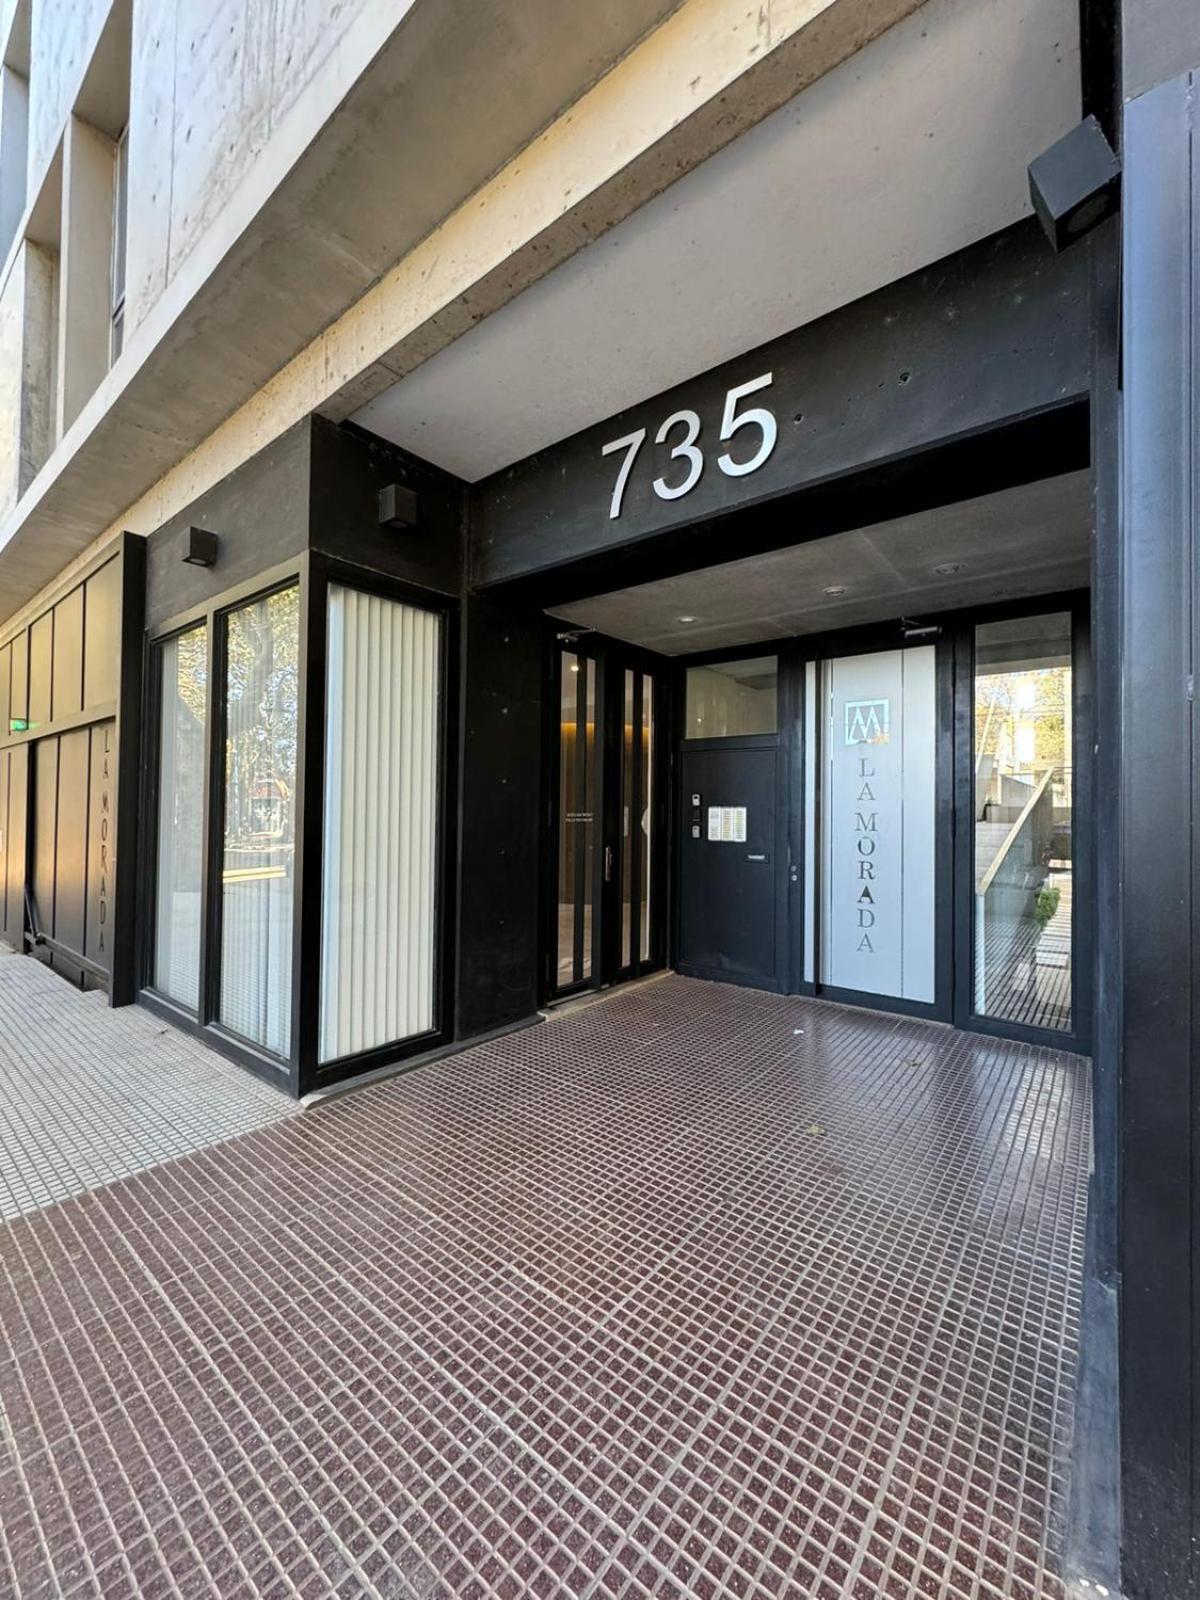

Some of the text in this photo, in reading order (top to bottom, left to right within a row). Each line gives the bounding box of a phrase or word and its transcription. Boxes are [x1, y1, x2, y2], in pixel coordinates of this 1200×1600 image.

[601, 372, 777, 519] 735
[98, 729, 110, 953] LA MORADA
[854, 758, 878, 953] LA MORADA
